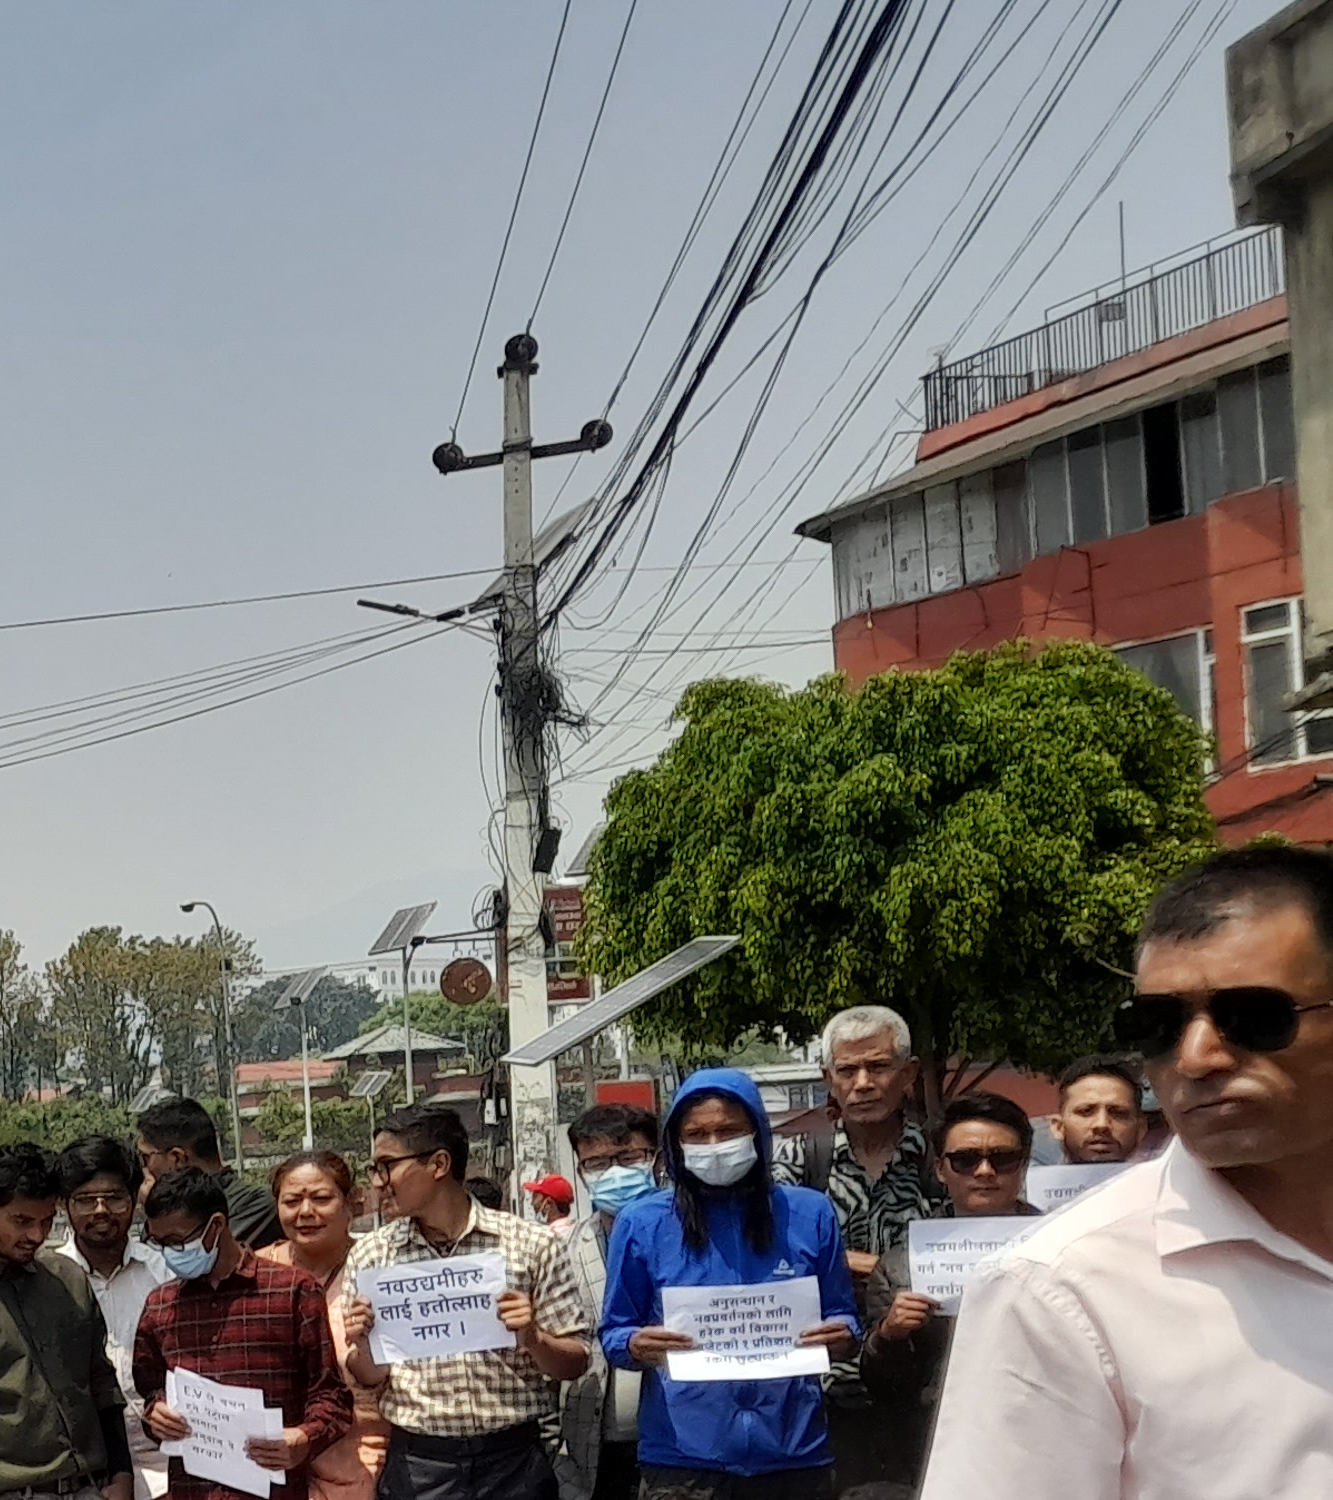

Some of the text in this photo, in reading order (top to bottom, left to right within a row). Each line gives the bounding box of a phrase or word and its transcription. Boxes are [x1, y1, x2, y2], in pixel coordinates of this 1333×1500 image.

[376, 1267, 484, 1295] नवउद्यमीहरु
[378, 1293, 492, 1321] लाई हतोत्साह
[765, 1304, 793, 1318] लागि
[411, 1322, 451, 1340] नगर
[702, 1336, 740, 1351] जेटको
